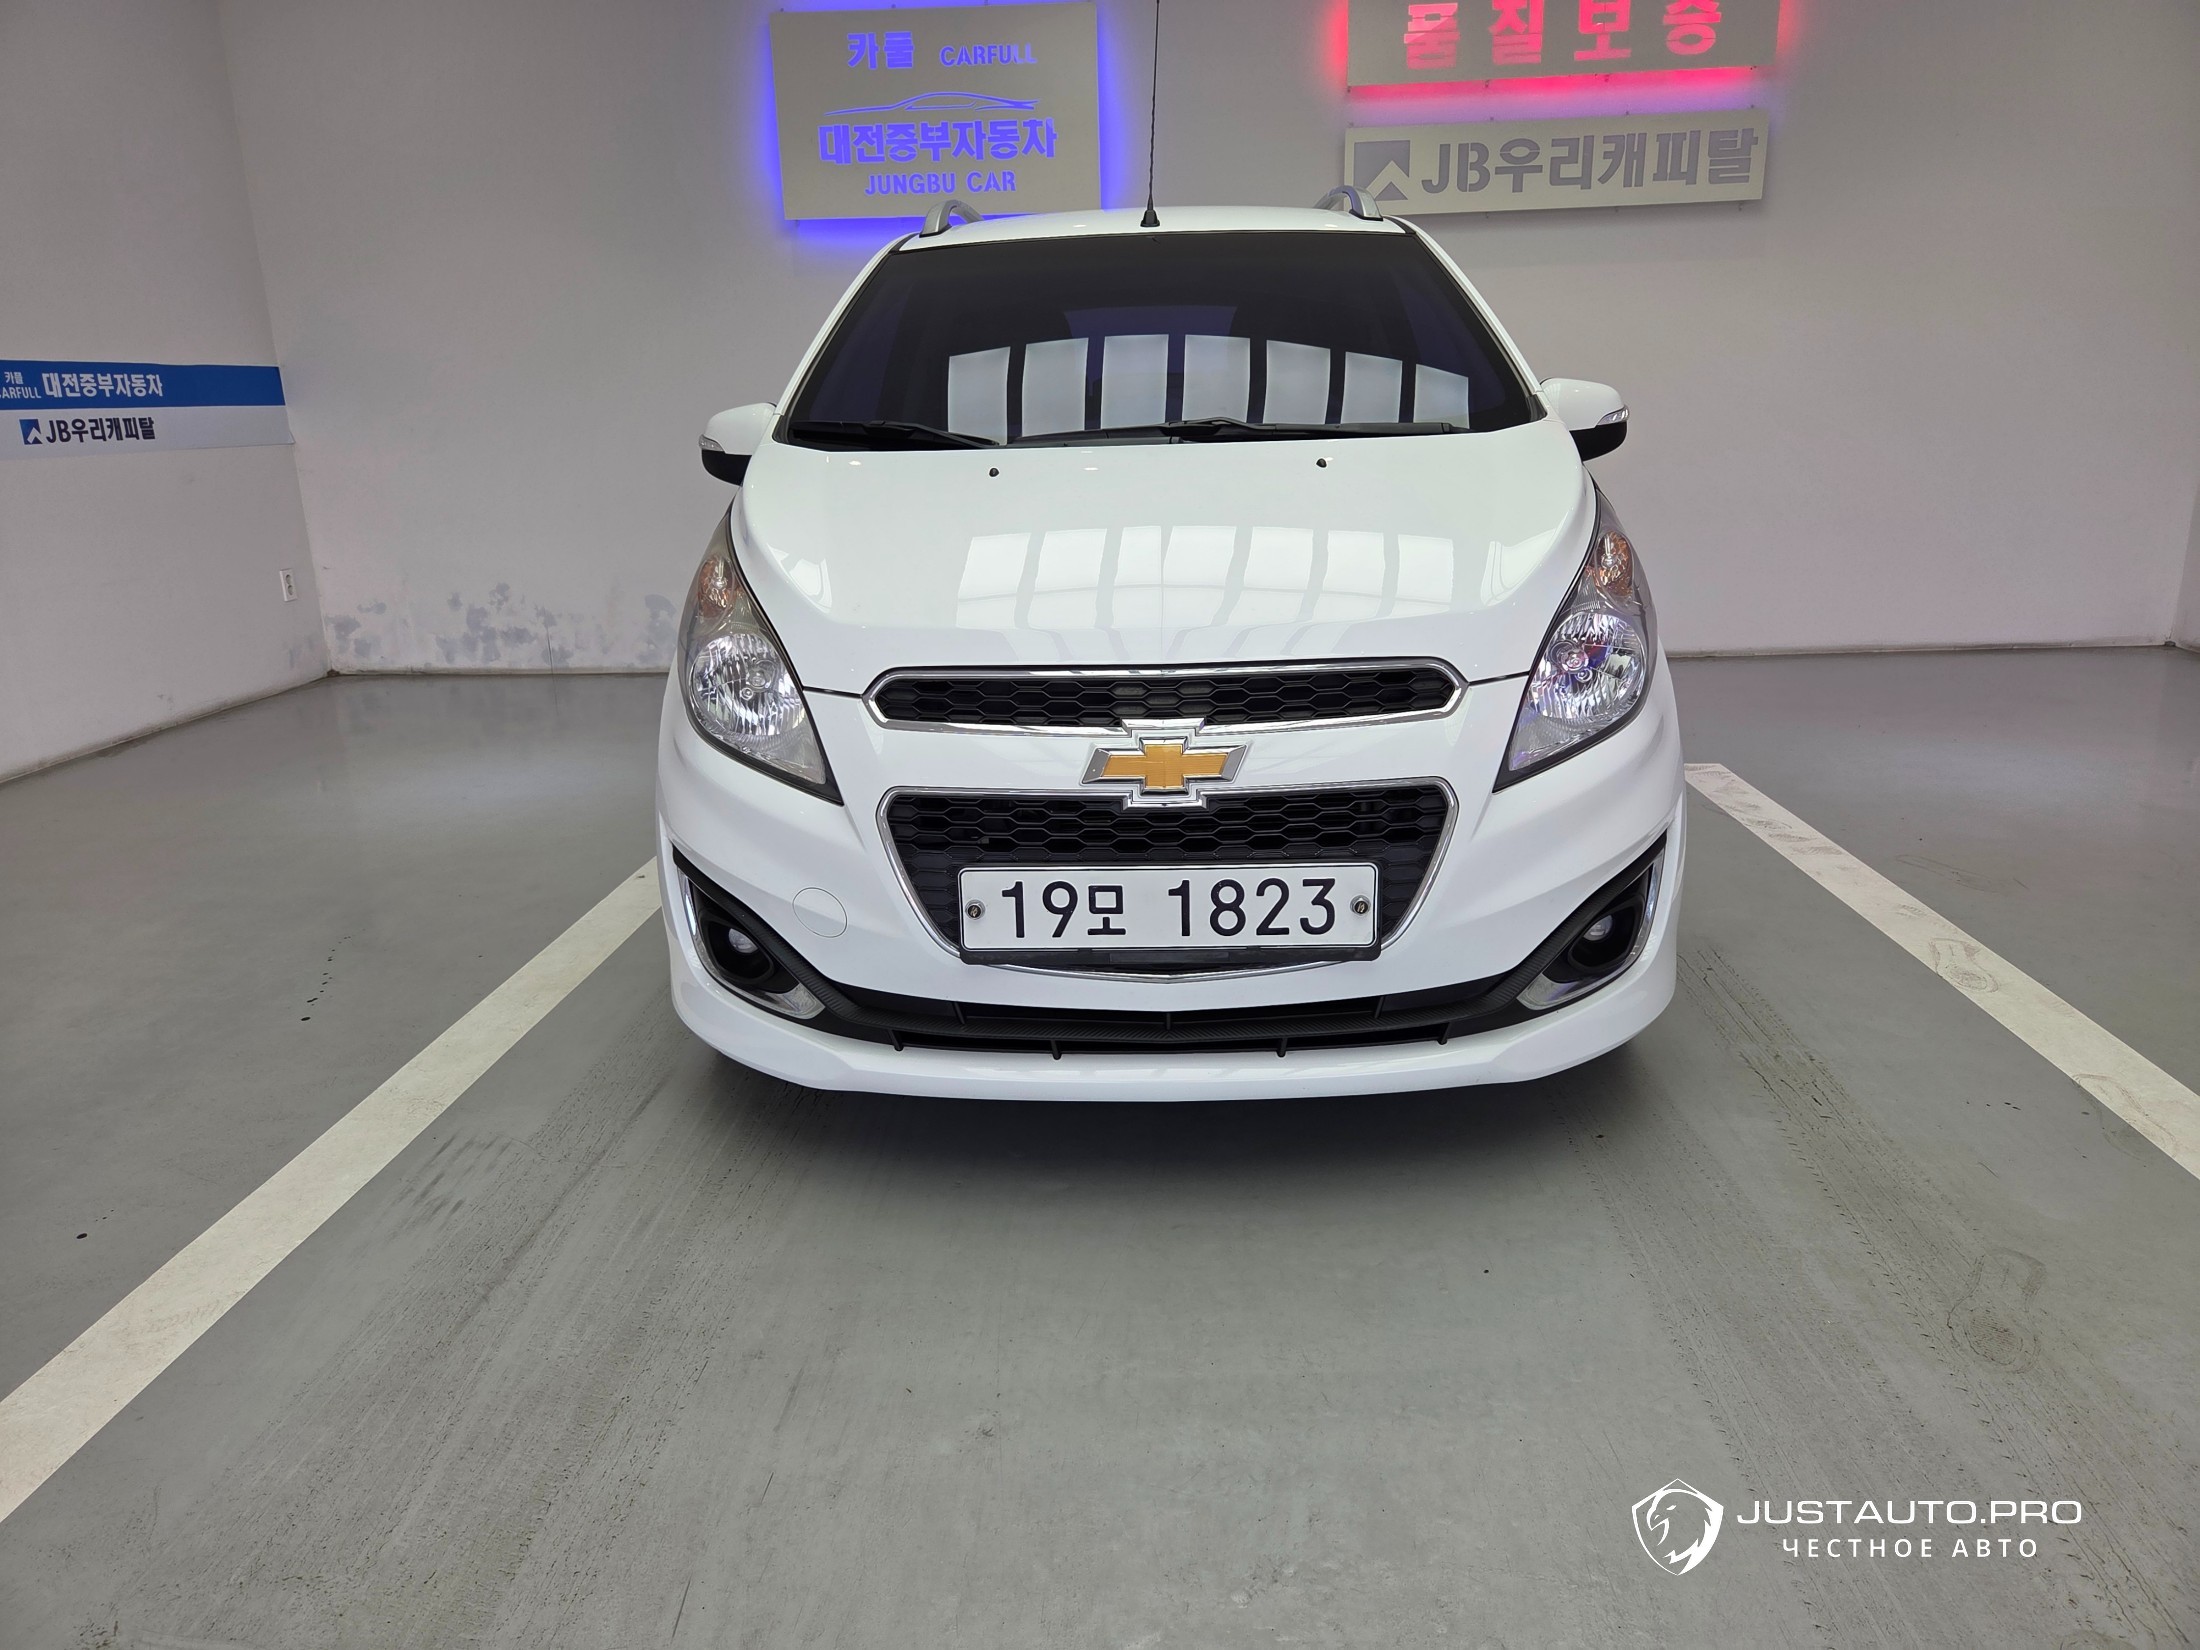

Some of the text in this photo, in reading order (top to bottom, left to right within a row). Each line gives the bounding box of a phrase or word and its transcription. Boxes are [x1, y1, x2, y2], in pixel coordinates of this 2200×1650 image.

[939, 43, 1038, 67] CARFULL
[817, 118, 1058, 165] 대전중부자동차
[1421, 127, 1759, 194] JB우리캐피탈
[865, 171, 1017, 195] JUNGBU CAR
[0, 386, 42, 399] ARFULL
[41, 372, 164, 398] 대전중부자동차
[45, 416, 156, 444] JB우리캐피탈
[1001, 877, 1337, 938] 19모 1823
